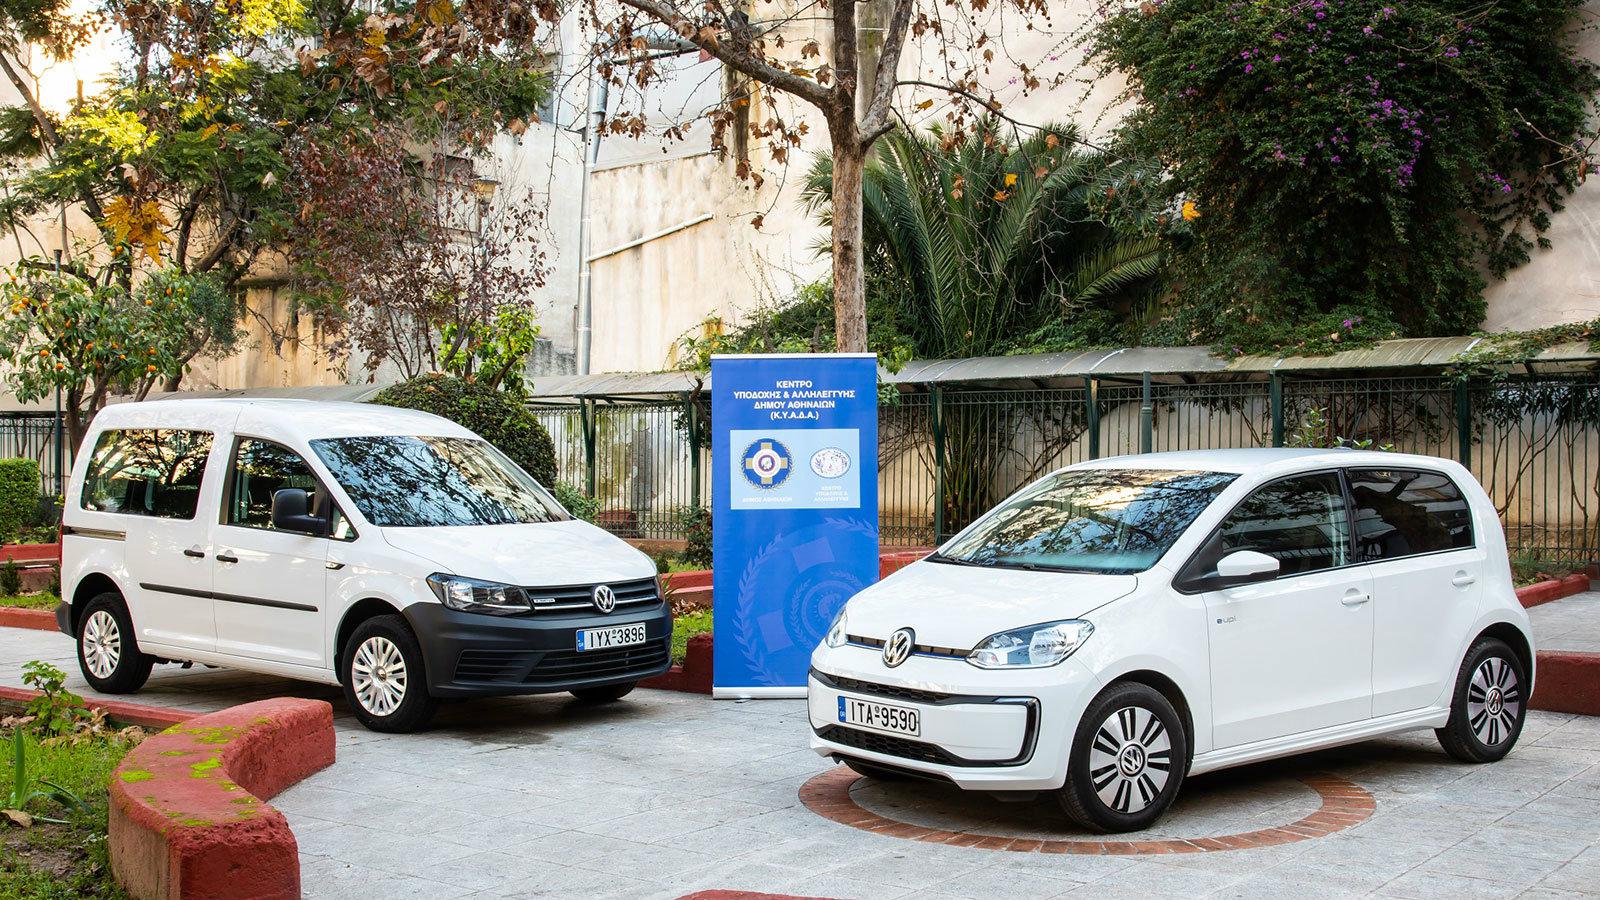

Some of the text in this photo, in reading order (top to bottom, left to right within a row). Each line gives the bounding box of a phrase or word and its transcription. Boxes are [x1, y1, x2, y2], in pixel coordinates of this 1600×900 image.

[776, 380, 813, 389] ΚΕΝΤΡΟ
[733, 390, 855, 399] ΥΠΟΔΟΧΗΣ & ΑΛΛΗΛΕΓΓΥΗΣ
[753, 400, 835, 409] ΔΗΜΟΥ ΑΘΗΝΑΙΩΝ
[770, 411, 819, 420] (Κ.Υ.Α.Δ.Α.)
